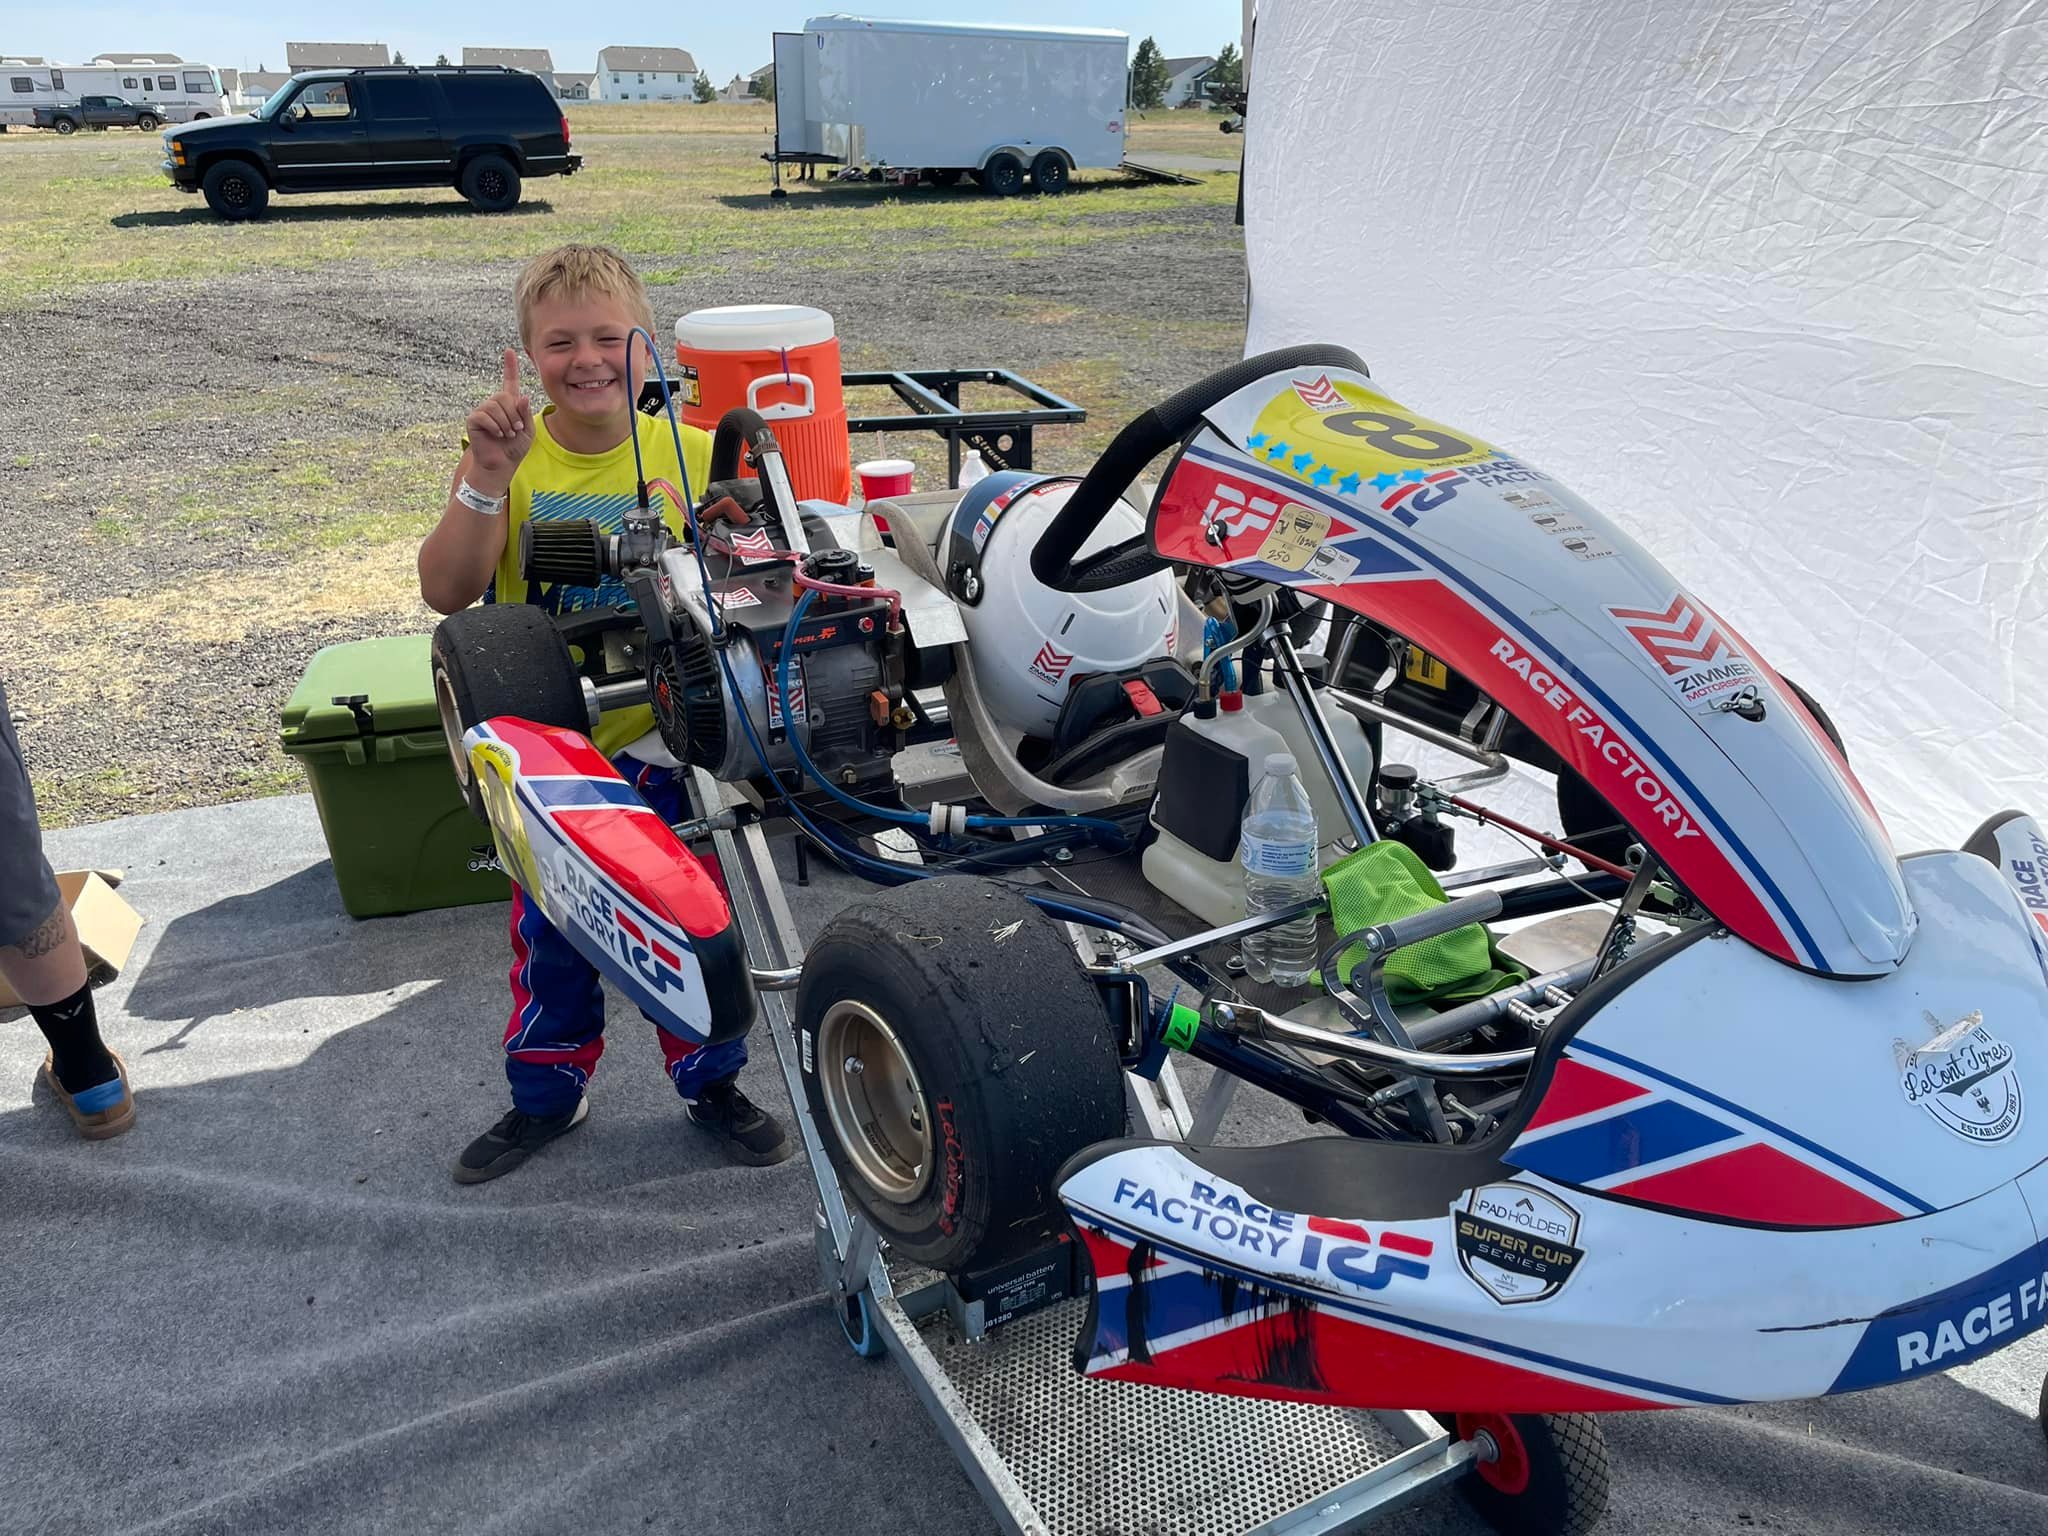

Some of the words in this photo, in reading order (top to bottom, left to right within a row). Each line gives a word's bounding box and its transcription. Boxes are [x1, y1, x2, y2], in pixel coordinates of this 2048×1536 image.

[1322, 412, 1473, 460] 8
[1457, 461, 1528, 476] RACE
[1267, 549, 1291, 564] 250
[1028, 664, 1058, 684] ZIMMER
[1674, 663, 1755, 694] ZIMMER
[1490, 638, 1572, 711] RACE
[1566, 706, 1701, 840] FACTORY
[564, 859, 613, 926] RACE
[2012, 860, 2048, 909] RACE
[1904, 1053, 1966, 1101] LeCont
[1960, 1043, 2012, 1074] Tyres
[1961, 1116, 2012, 1137] ESTABLISHED
[2008, 1093, 2018, 1116] 1993
[1113, 1177, 1290, 1258] FACTORY
[1190, 1180, 1296, 1233] RACE
[1460, 1221, 1528, 1255] SUPER
[1531, 1244, 1573, 1266] CUP
[1478, 1243, 1548, 1273] SERIES
[987, 1274, 1025, 1295] universal
[1026, 1262, 1057, 1280] battery
[1897, 1293, 2015, 1373] RACE
